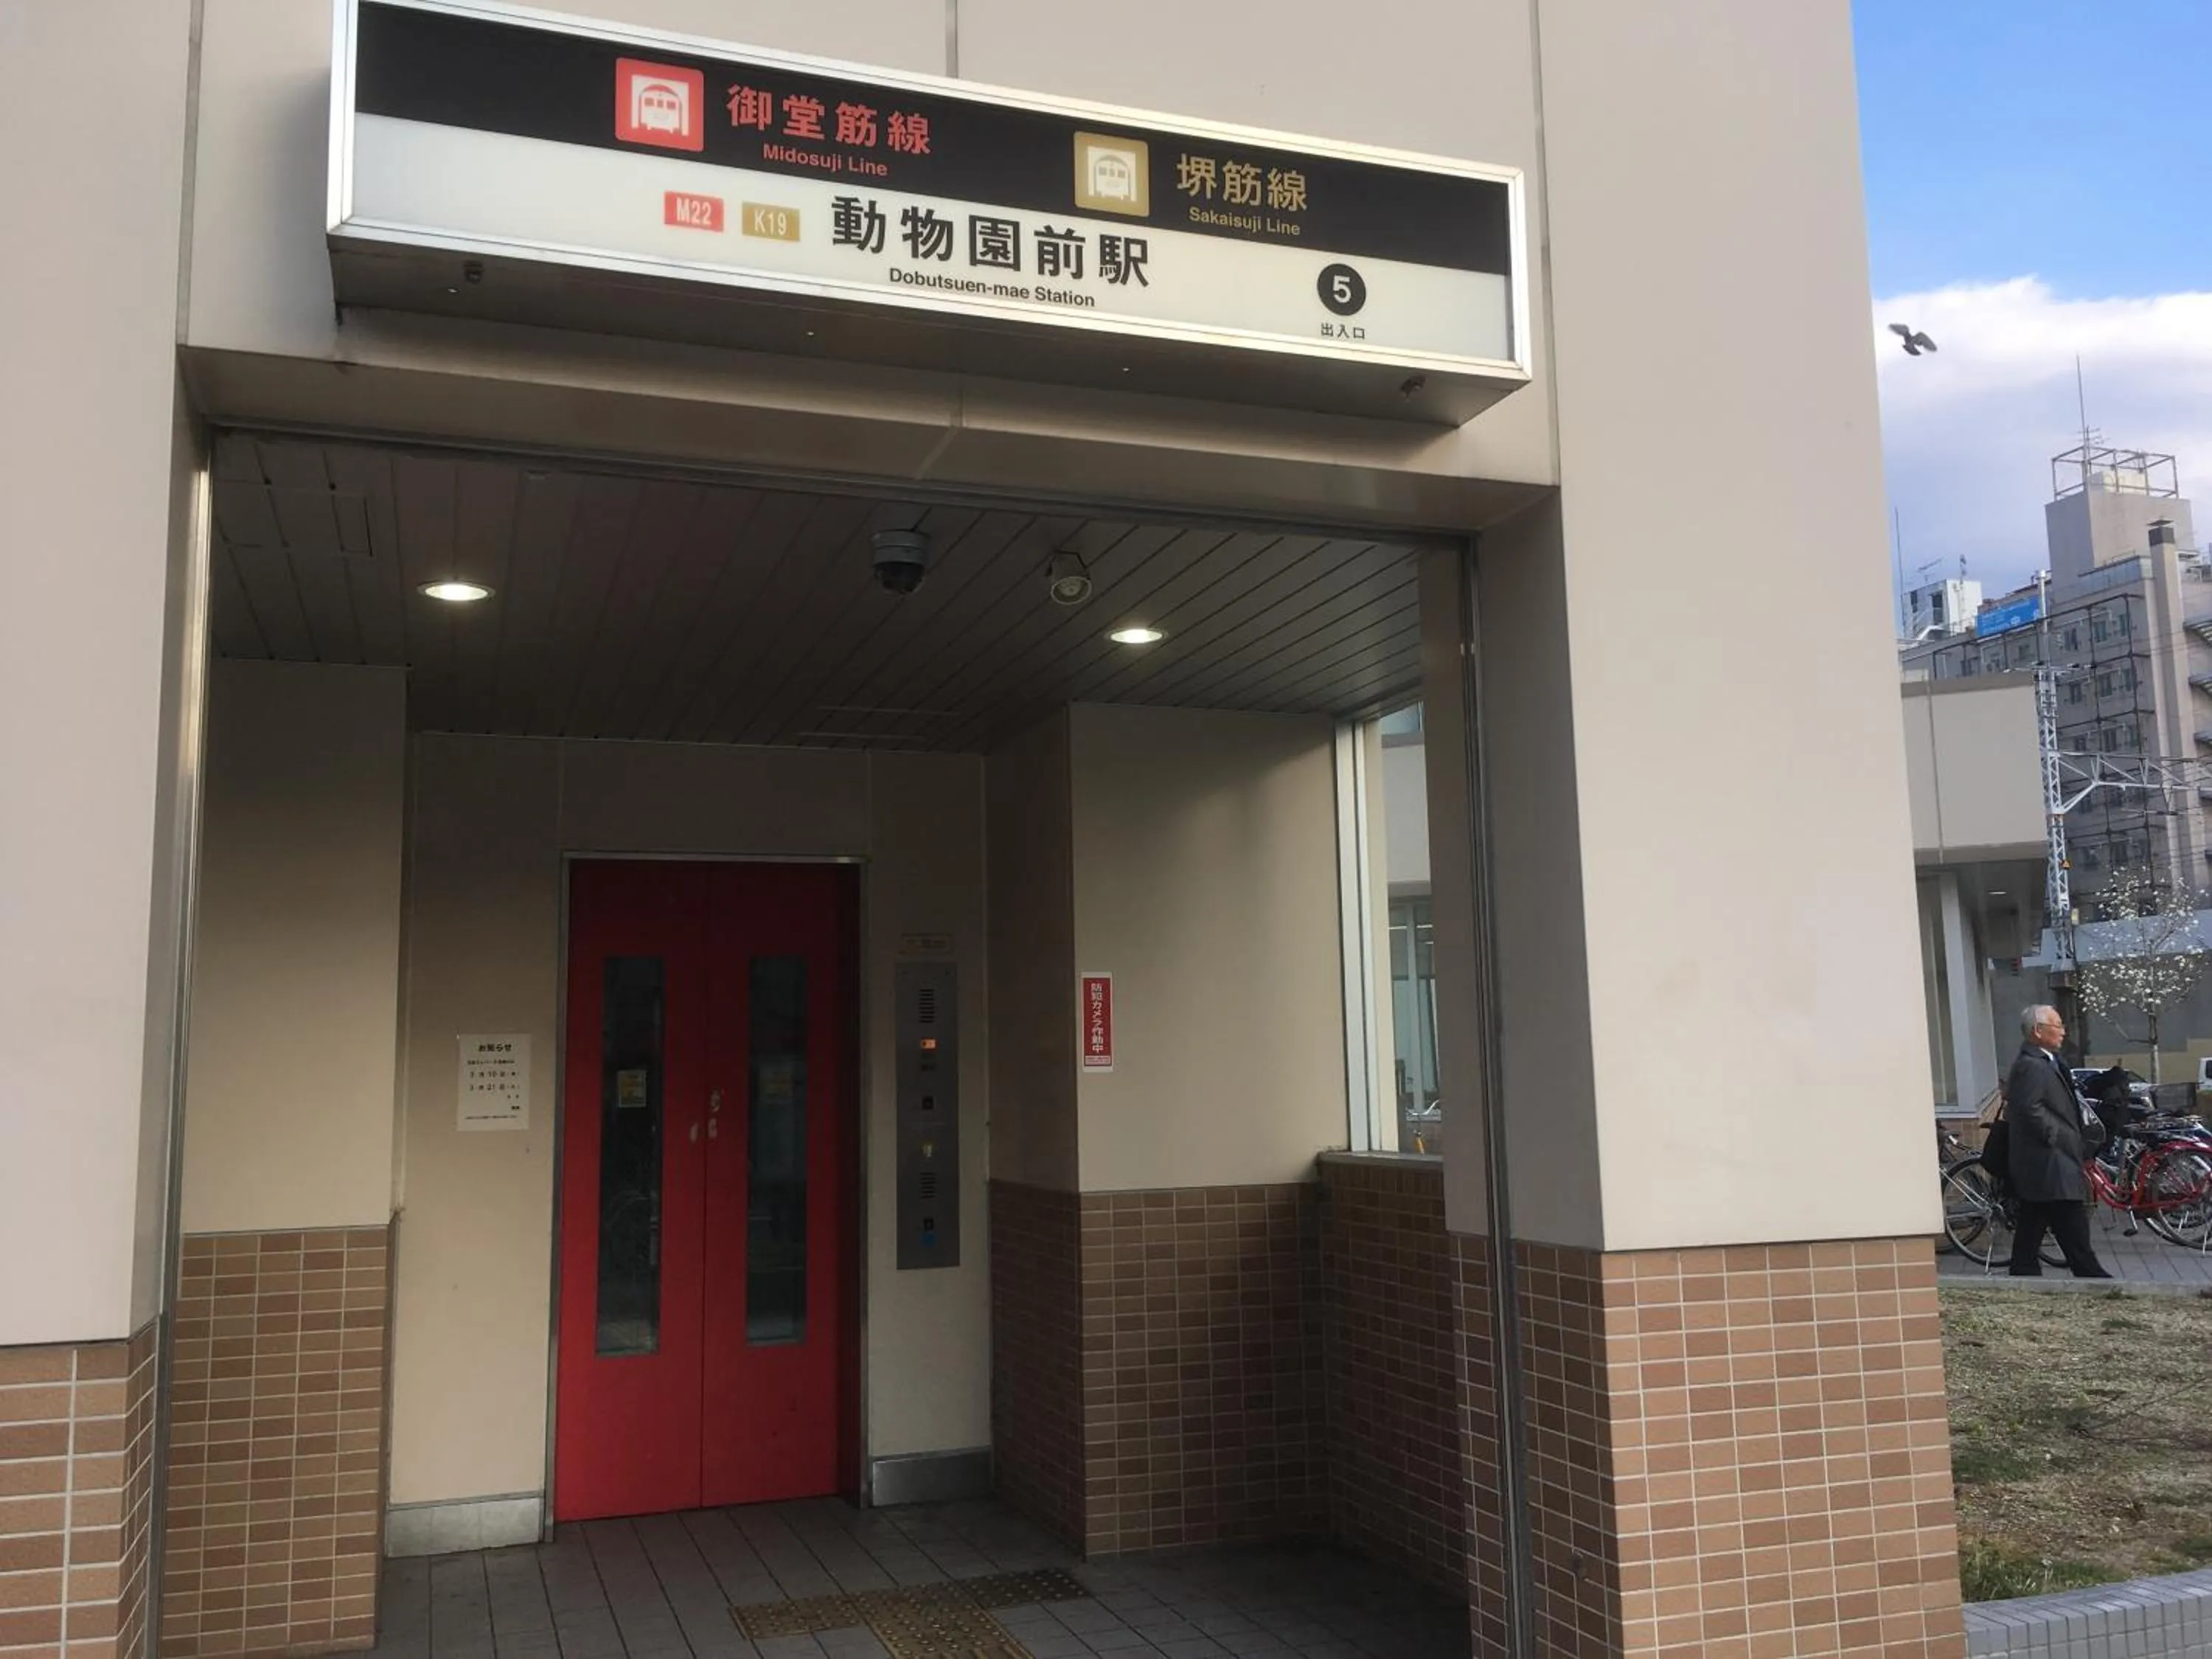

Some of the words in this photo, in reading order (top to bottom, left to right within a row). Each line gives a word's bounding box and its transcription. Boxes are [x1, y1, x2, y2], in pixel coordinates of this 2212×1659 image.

[726, 84, 931, 155] 御堂筋線
[763, 143, 842, 173] Midosuji
[849, 156, 888, 177] Line
[1177, 153, 1308, 212] 堺筋線
[675, 196, 712, 226] M22
[754, 211, 787, 237] K19
[1189, 206, 1262, 233] Sakaisuji
[1267, 217, 1301, 236] Line
[831, 195, 1150, 288] 動物園前駅
[889, 268, 1030, 299] Dobutsuen-mae
[1034, 285, 1096, 307] Station
[1332, 275, 1352, 305] 5
[1321, 323, 1366, 340] 出入口
